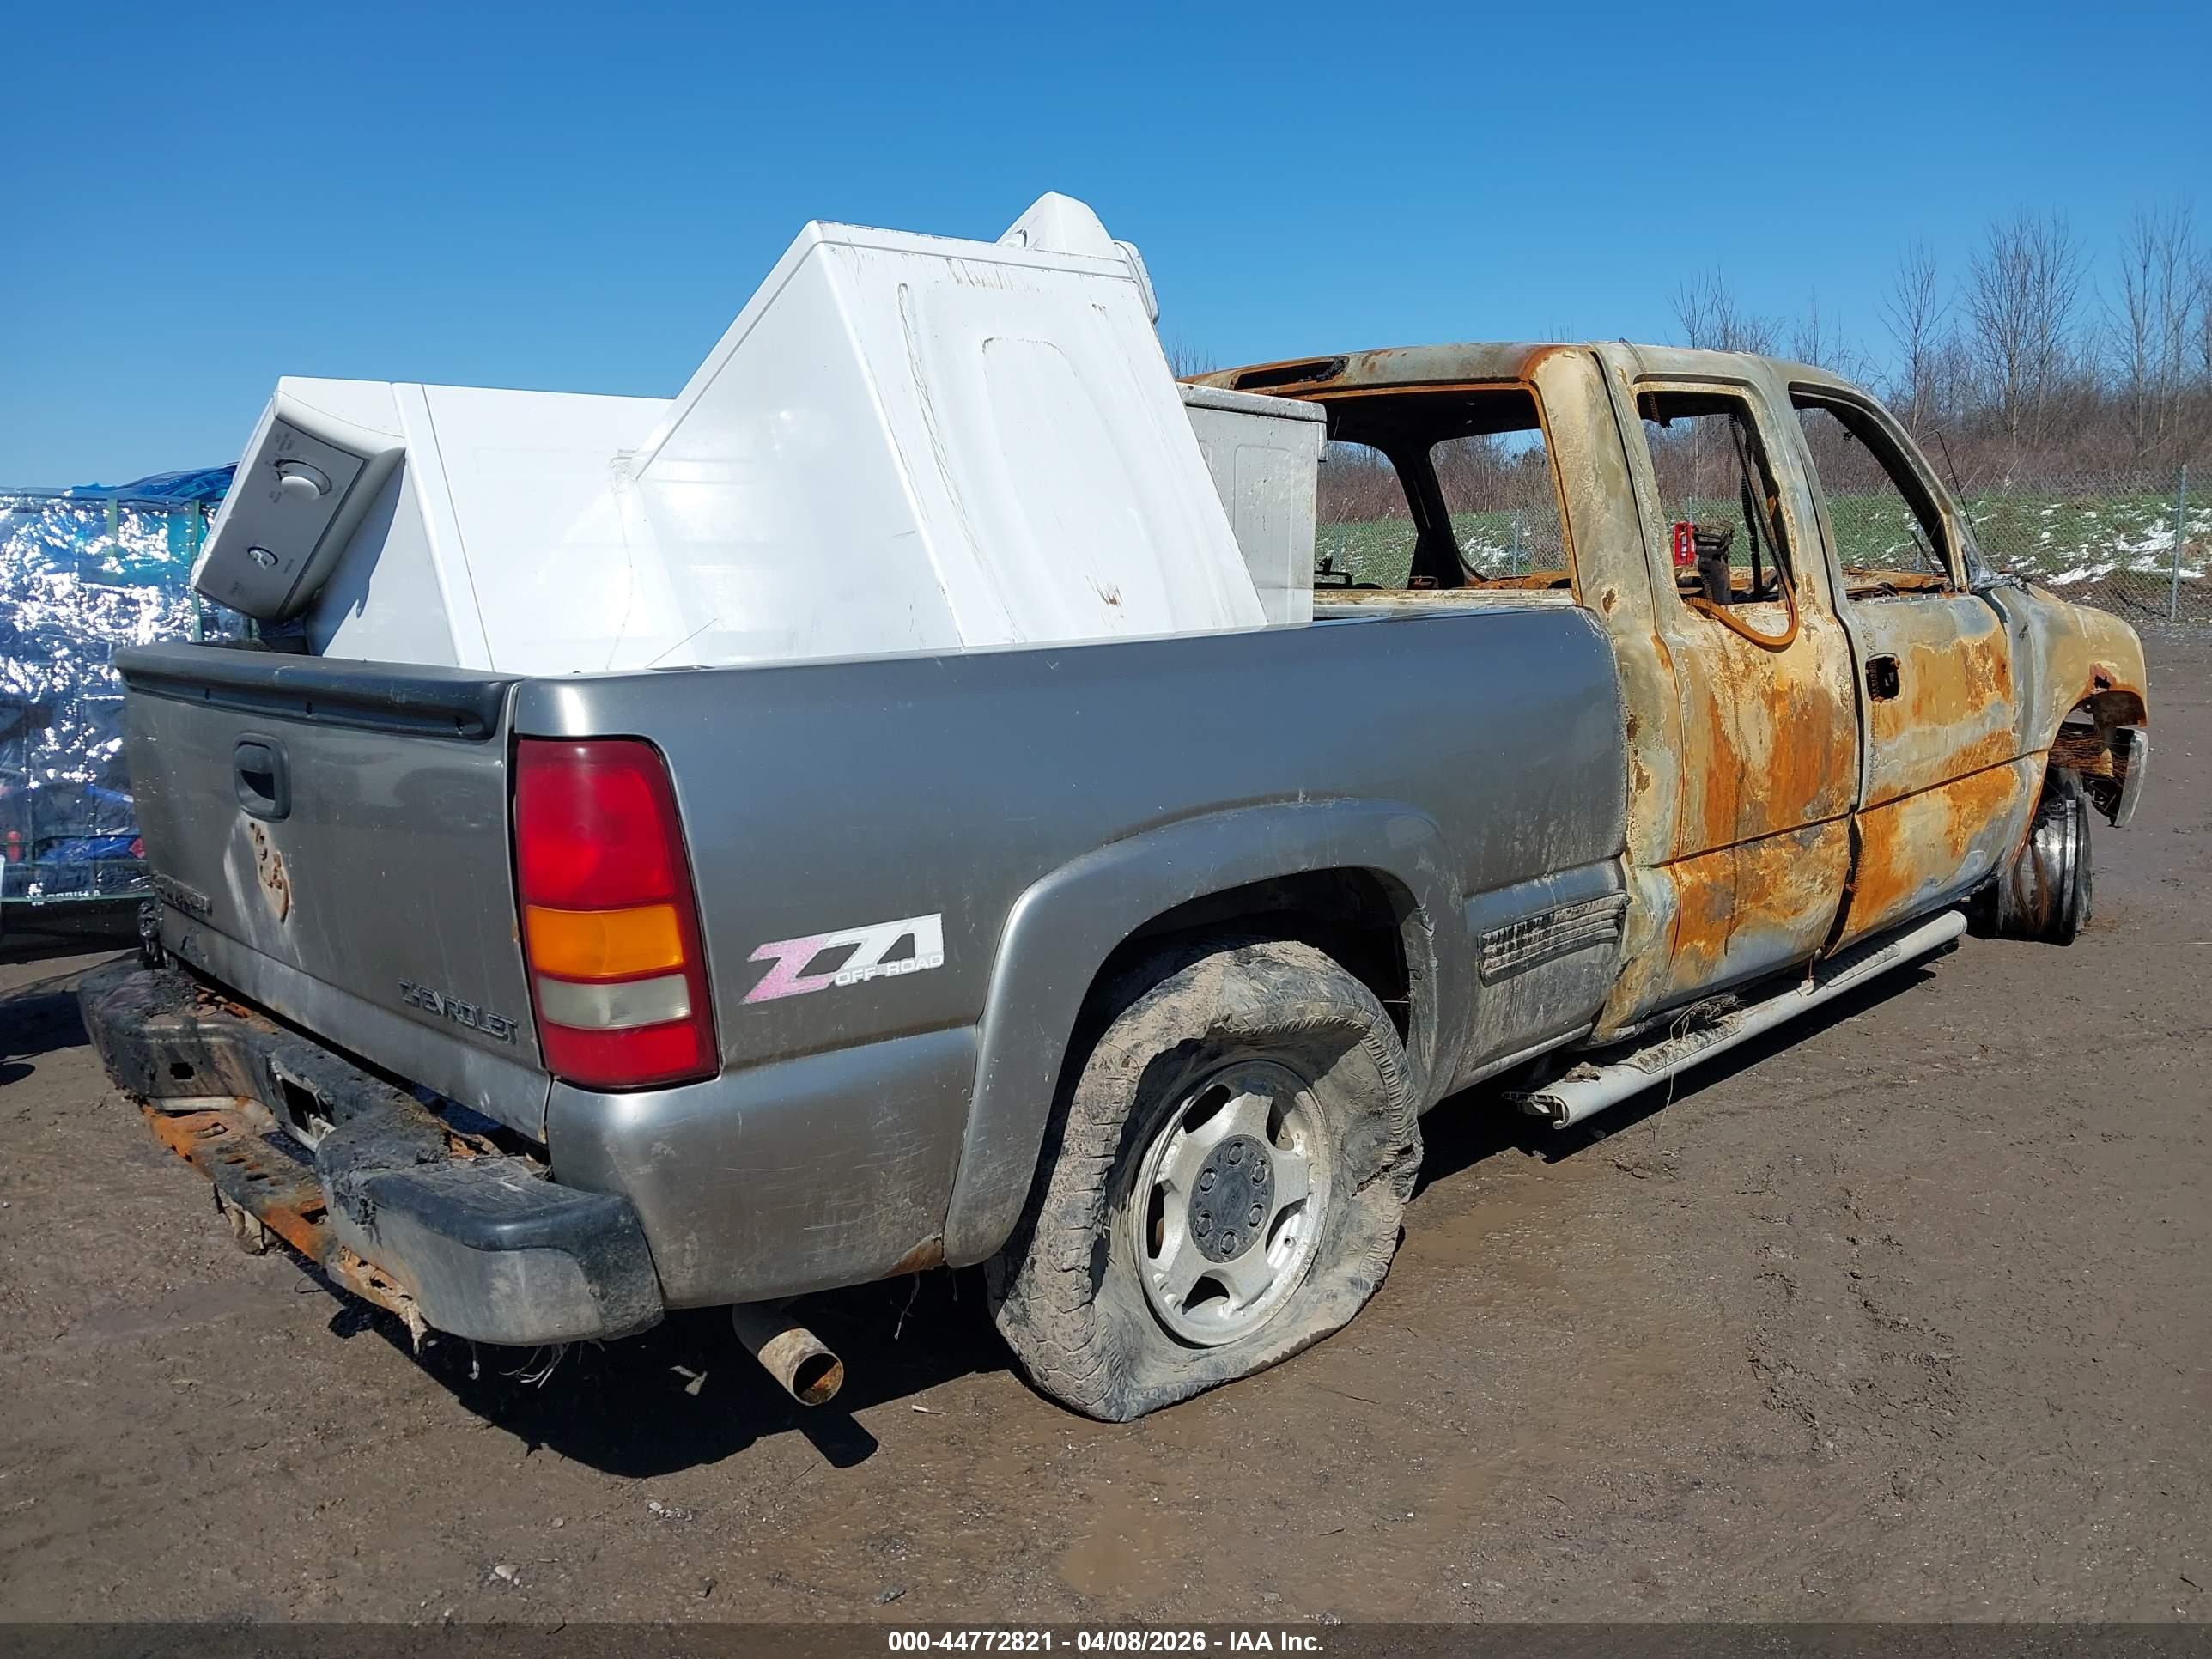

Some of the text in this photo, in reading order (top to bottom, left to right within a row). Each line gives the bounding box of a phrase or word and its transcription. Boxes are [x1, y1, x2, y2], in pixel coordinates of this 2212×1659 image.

[739, 912, 945, 1006] Z71
[835, 953, 945, 987] OFF ROAD
[398, 979, 517, 1045] CHEVROLET
